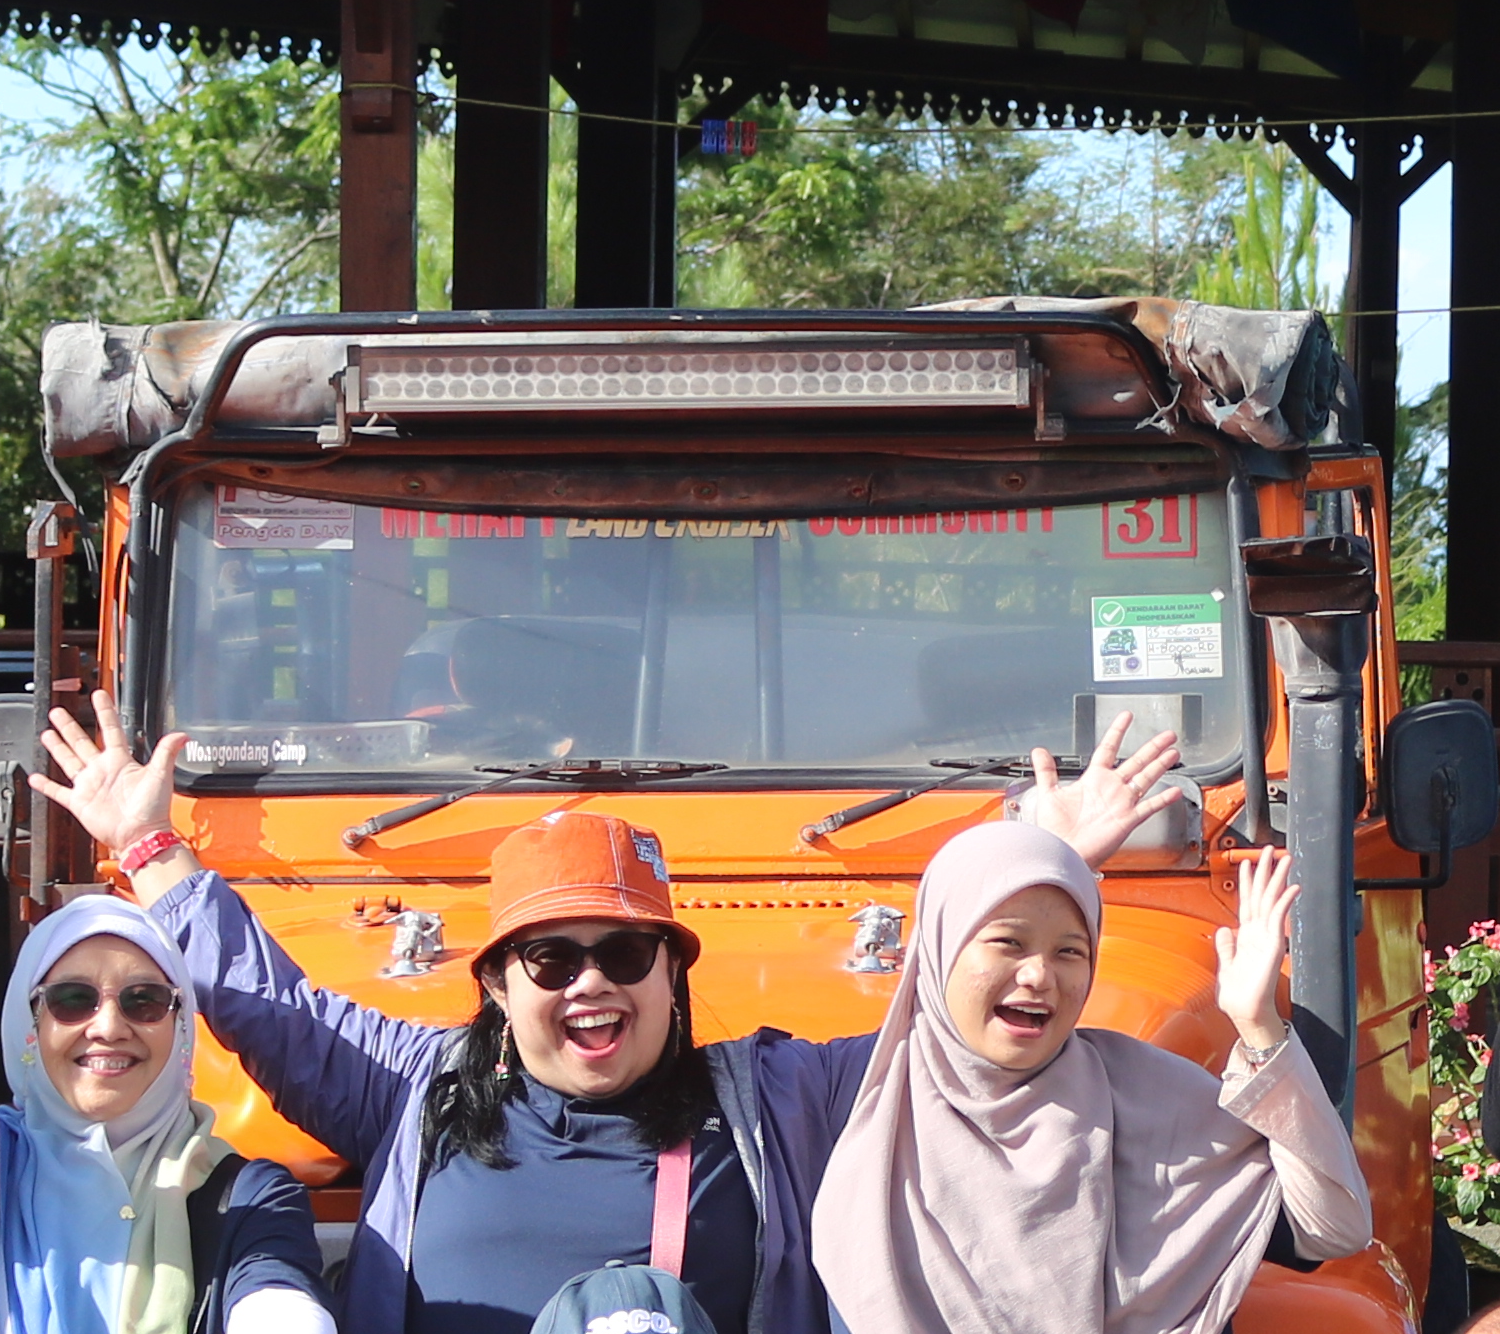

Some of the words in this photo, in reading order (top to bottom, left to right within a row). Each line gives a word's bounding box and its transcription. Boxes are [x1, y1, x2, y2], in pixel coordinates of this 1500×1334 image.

[1116, 495, 1183, 544] 31
[219, 524, 295, 542] Pengda
[271, 739, 306, 765] Camp
